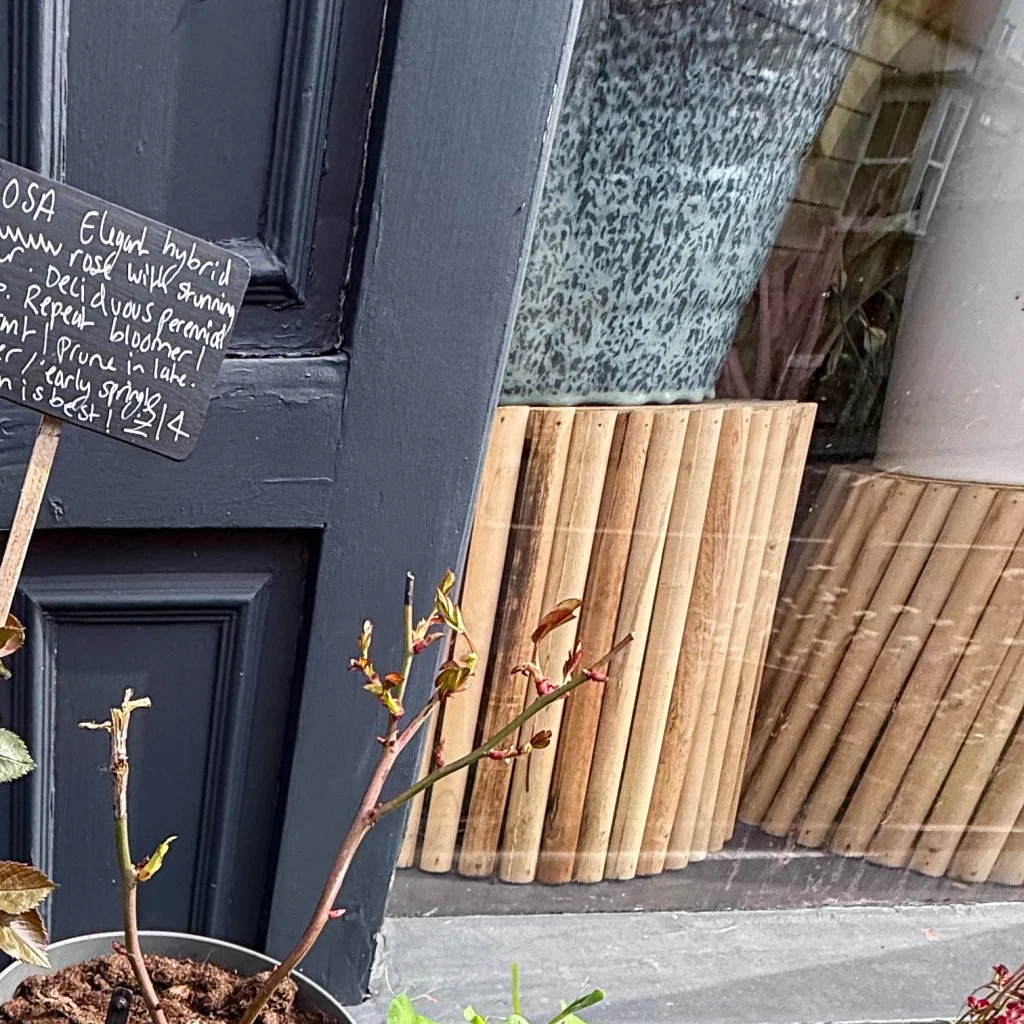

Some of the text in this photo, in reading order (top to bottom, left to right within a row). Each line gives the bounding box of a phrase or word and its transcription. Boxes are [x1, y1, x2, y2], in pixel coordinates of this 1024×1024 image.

[163, 229, 231, 286] hybrid
[24, 284, 95, 331] Repeat
[69, 249, 236, 334] rose with stunning
[127, 351, 145, 376] in
[20, 378, 44, 402] is
[45, 365, 91, 409] early
